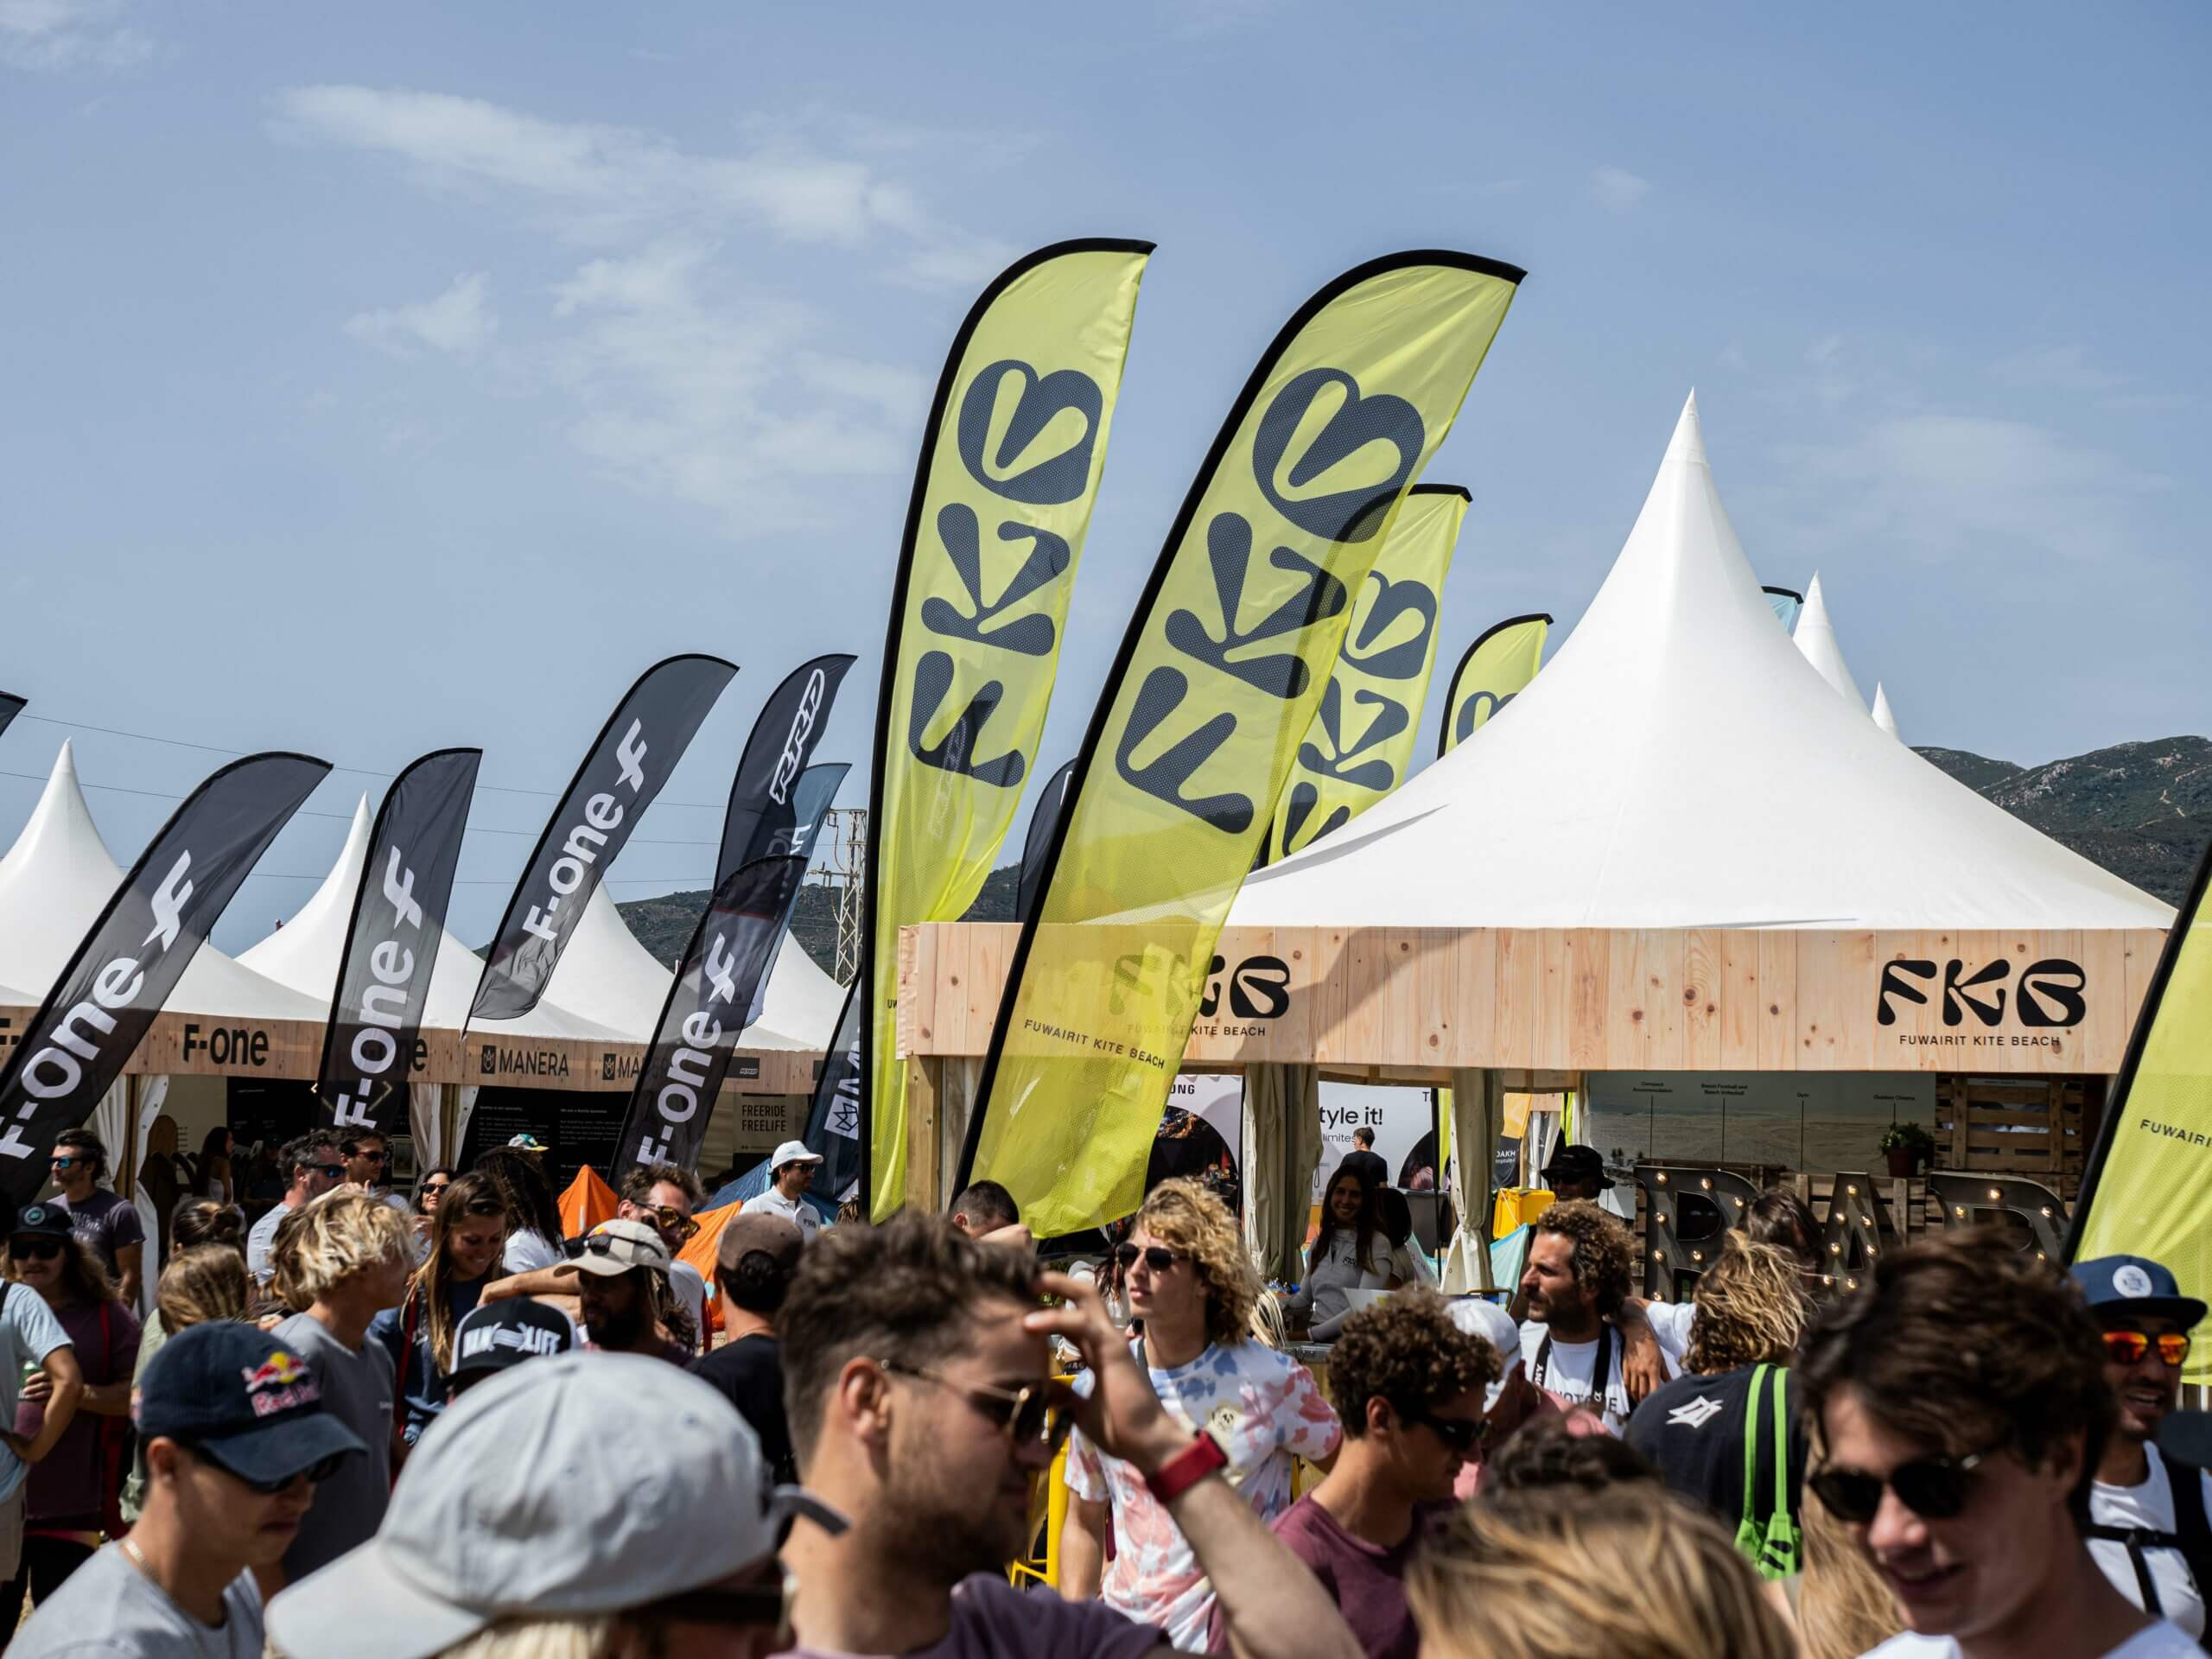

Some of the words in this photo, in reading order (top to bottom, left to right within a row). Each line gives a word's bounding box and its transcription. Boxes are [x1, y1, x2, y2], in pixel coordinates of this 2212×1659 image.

[908, 359, 1103, 788] FKB
[1116, 367, 1425, 835] FKB
[522, 792, 624, 941] F-one
[1878, 958, 2086, 1027] FKB
[183, 1024, 269, 1066] F-one
[334, 940, 415, 1129] F-one
[1024, 1019, 1089, 1046] FUWAIRIT
[1093, 1038, 1123, 1055] KITE
[1129, 1048, 1165, 1070] BEACH
[1192, 1026, 1217, 1036] KITE
[1224, 1026, 1266, 1037] BEACH
[1899, 1035, 1967, 1046] FUWAIRIT
[1974, 1035, 2005, 1046] KITE
[2012, 1036, 2061, 1046] BEACH
[0, 957, 144, 1160] F-one
[499, 1048, 569, 1077] MANERA
[637, 1011, 721, 1166] F-one
[741, 1104, 786, 1118] FREERIDE
[741, 1120, 786, 1132] FREELIFE
[1319, 1107, 1359, 1129] tyle
[1365, 1106, 1383, 1126] it!
[2140, 1119, 2212, 1147] FUWAIRI
